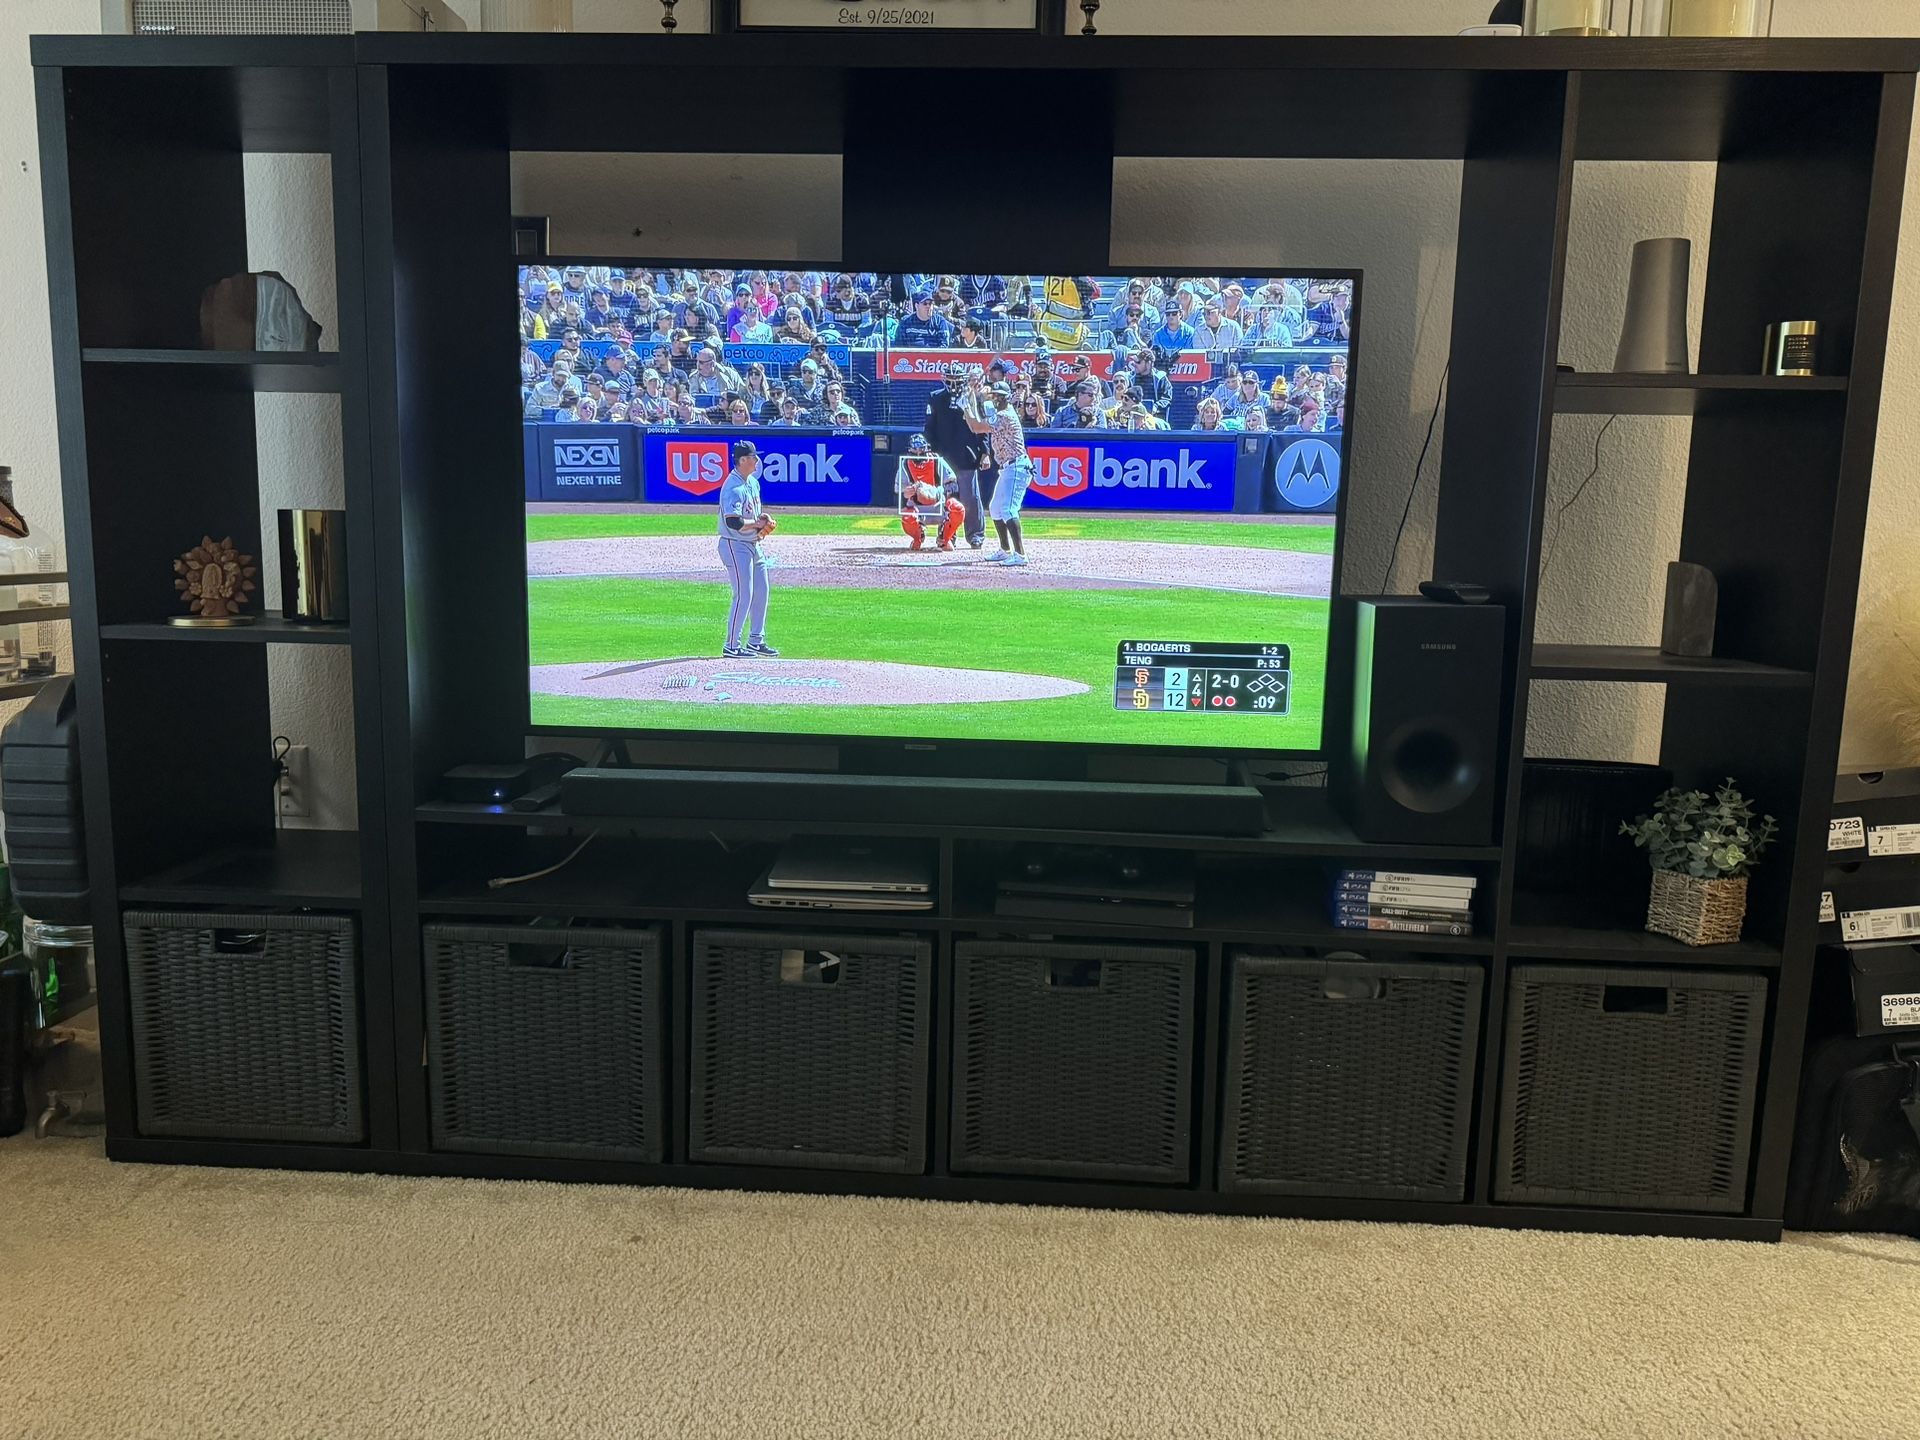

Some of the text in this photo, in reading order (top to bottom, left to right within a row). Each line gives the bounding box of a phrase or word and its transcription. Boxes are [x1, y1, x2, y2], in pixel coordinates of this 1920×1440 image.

[838, 8, 934, 24] Est. 9/25/2021
[723, 346, 765, 360] petco
[554, 445, 621, 466] NEXEN
[672, 451, 724, 483] us
[1032, 447, 1208, 490] us bank
[556, 475, 622, 486] NEXEN TIRE
[1124, 643, 1191, 653] 1. BOGAERTS
[1262, 647, 1278, 655] 1-2
[1125, 656, 1152, 665] TENG
[1268, 660, 1280, 668] 53
[1171, 672, 1181, 686] 2
[1212, 674, 1240, 689] 2-0
[1192, 683, 1201, 697] 4
[1167, 693, 1184, 707] 12
[1253, 696, 1276, 708] :09
[1877, 835, 1884, 845] 7
[1887, 1008, 1893, 1018] 7
